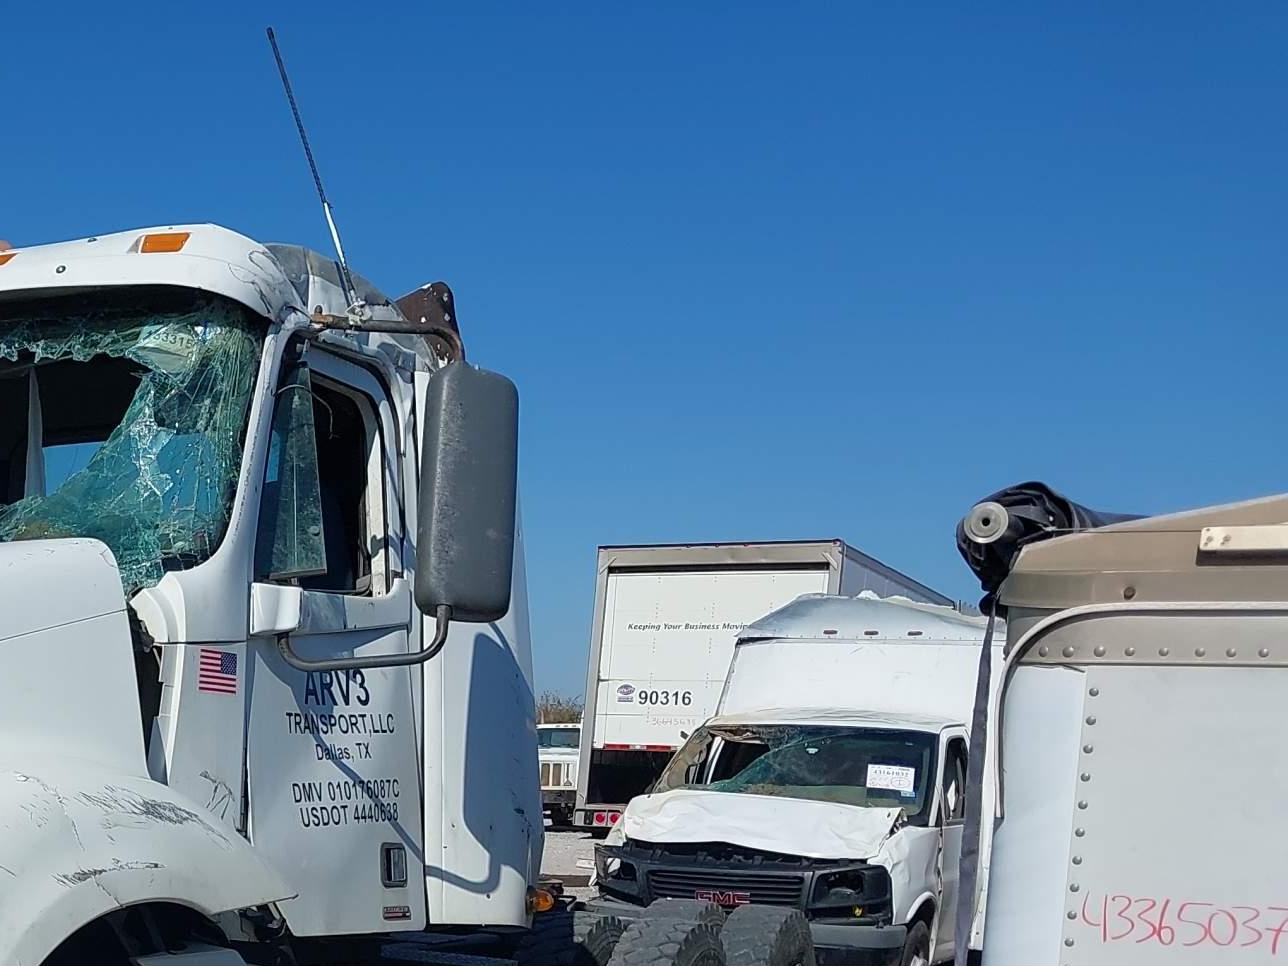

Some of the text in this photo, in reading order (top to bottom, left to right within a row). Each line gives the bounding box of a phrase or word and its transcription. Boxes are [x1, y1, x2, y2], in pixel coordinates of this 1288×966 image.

[627, 623, 661, 631] Keeping
[684, 622, 720, 630] Business
[304, 670, 370, 706] ARV3
[638, 690, 692, 706] 90316
[286, 712, 395, 737] TRANSPORT,LLC
[315, 742, 372, 762] Dallas, TX
[292, 779, 400, 803] DMV 010176087C
[300, 802, 398, 828] USDOT 4440638
[695, 890, 750, 904] GMC
[1082, 890, 1288, 955] 43365037
